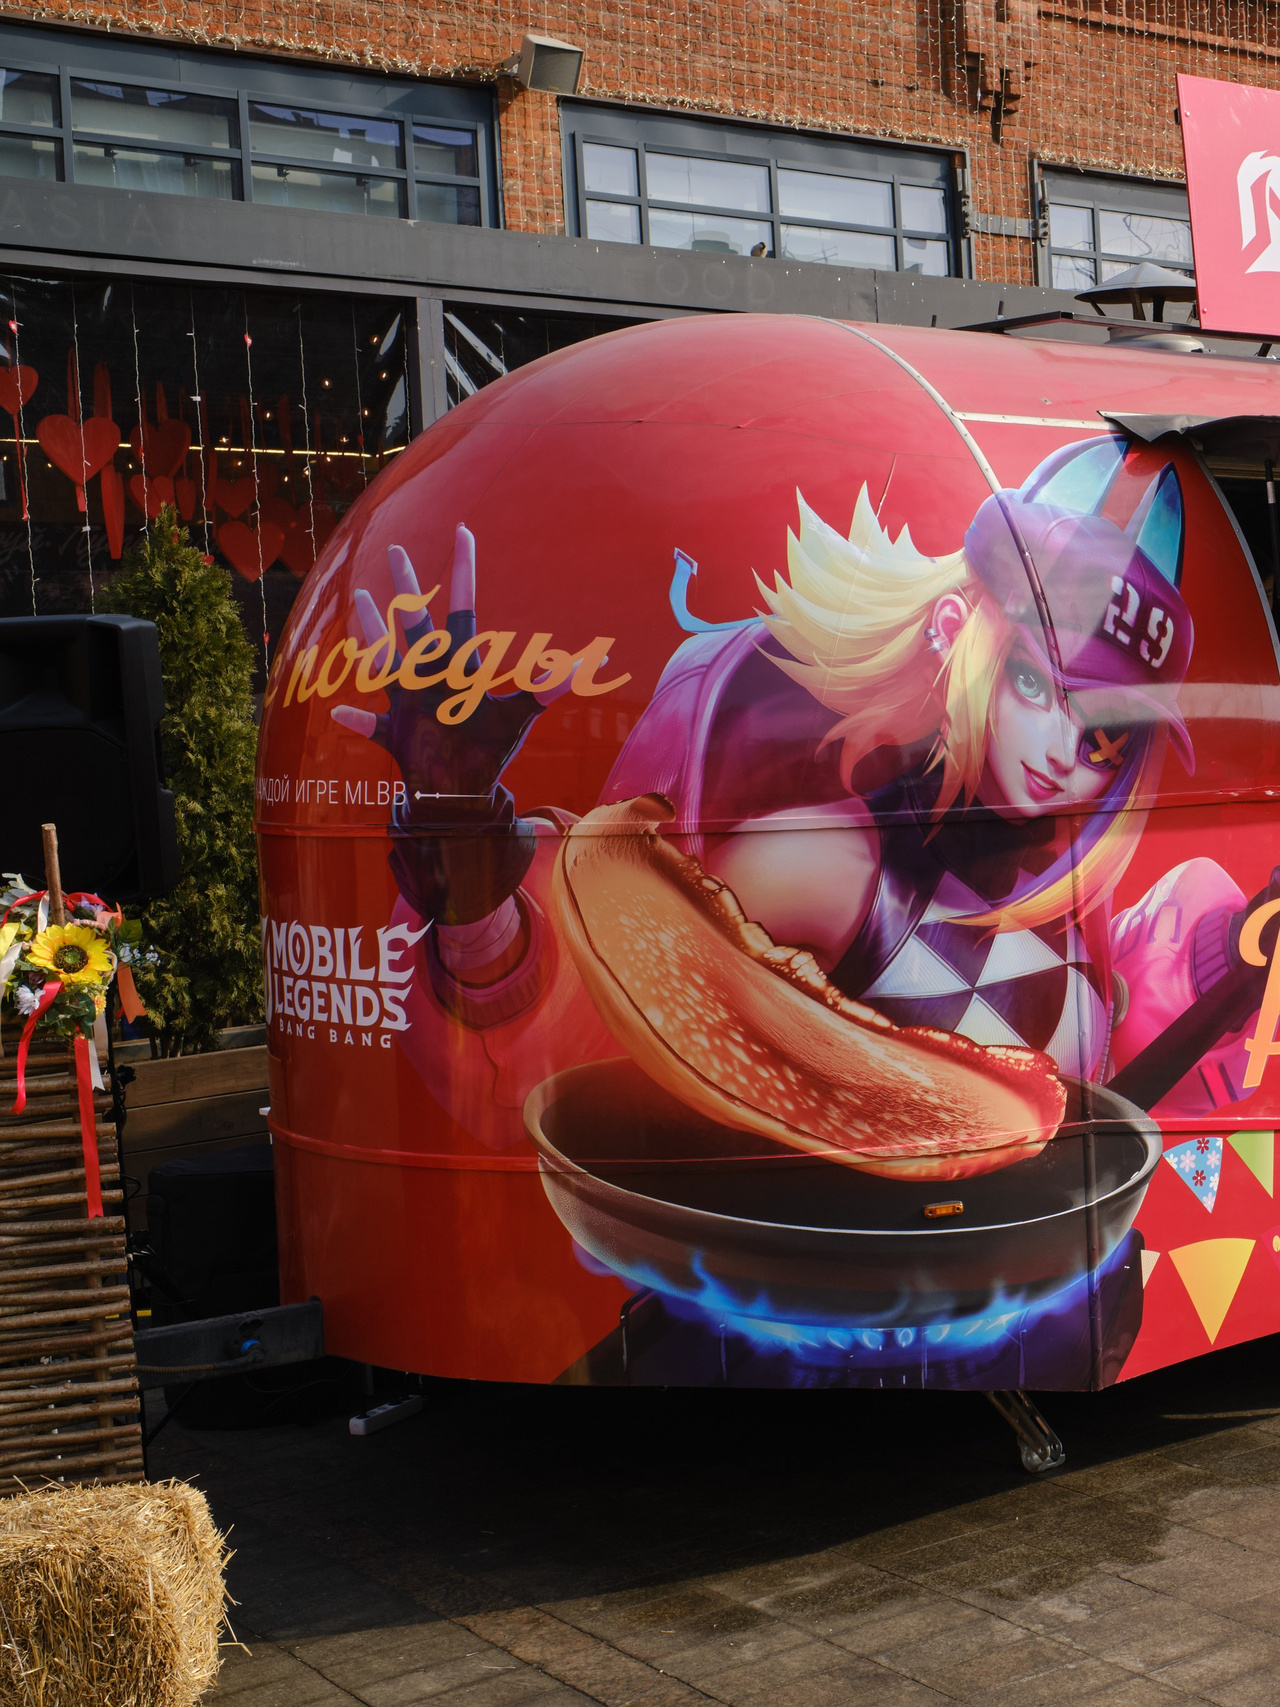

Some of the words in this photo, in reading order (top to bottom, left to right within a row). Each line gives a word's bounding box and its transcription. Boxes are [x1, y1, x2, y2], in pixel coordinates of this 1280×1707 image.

[1103, 575, 1174, 669] 29
[283, 584, 632, 726] победы
[295, 779, 339, 804] ИГРЕ
[345, 780, 407, 806] MLBB
[271, 917, 435, 984] MOBILE
[273, 973, 412, 1032] LEGENDS
[279, 1018, 316, 1040] BANG
[329, 1027, 392, 1049] BANG
